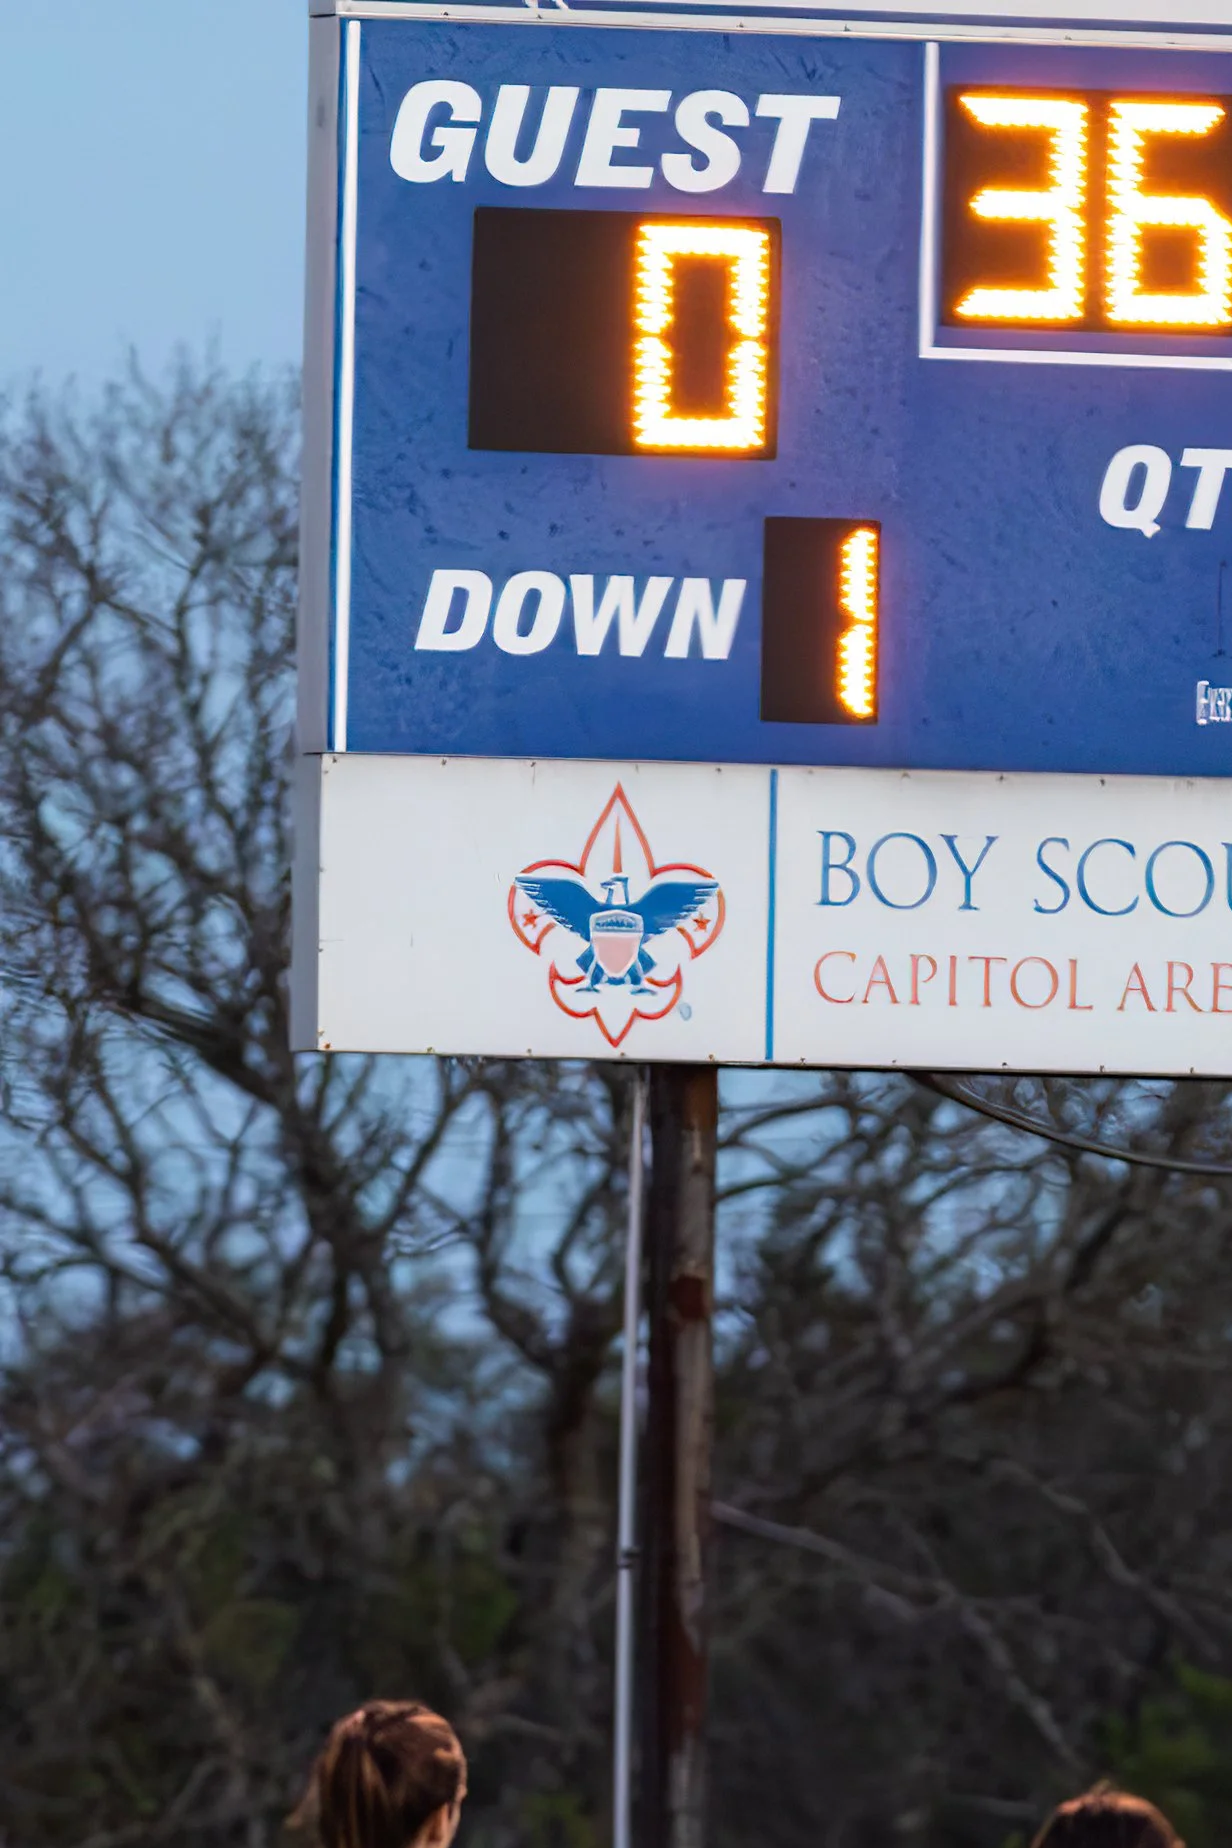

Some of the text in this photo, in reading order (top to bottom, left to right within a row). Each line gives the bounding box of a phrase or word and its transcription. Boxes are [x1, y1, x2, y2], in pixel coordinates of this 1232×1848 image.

[389, 80, 841, 194] GUEST
[632, 223, 769, 449] 0
[414, 526, 878, 719] DOWN 1
[815, 829, 999, 912] BOY
[813, 951, 1094, 1011] CAPITOL
